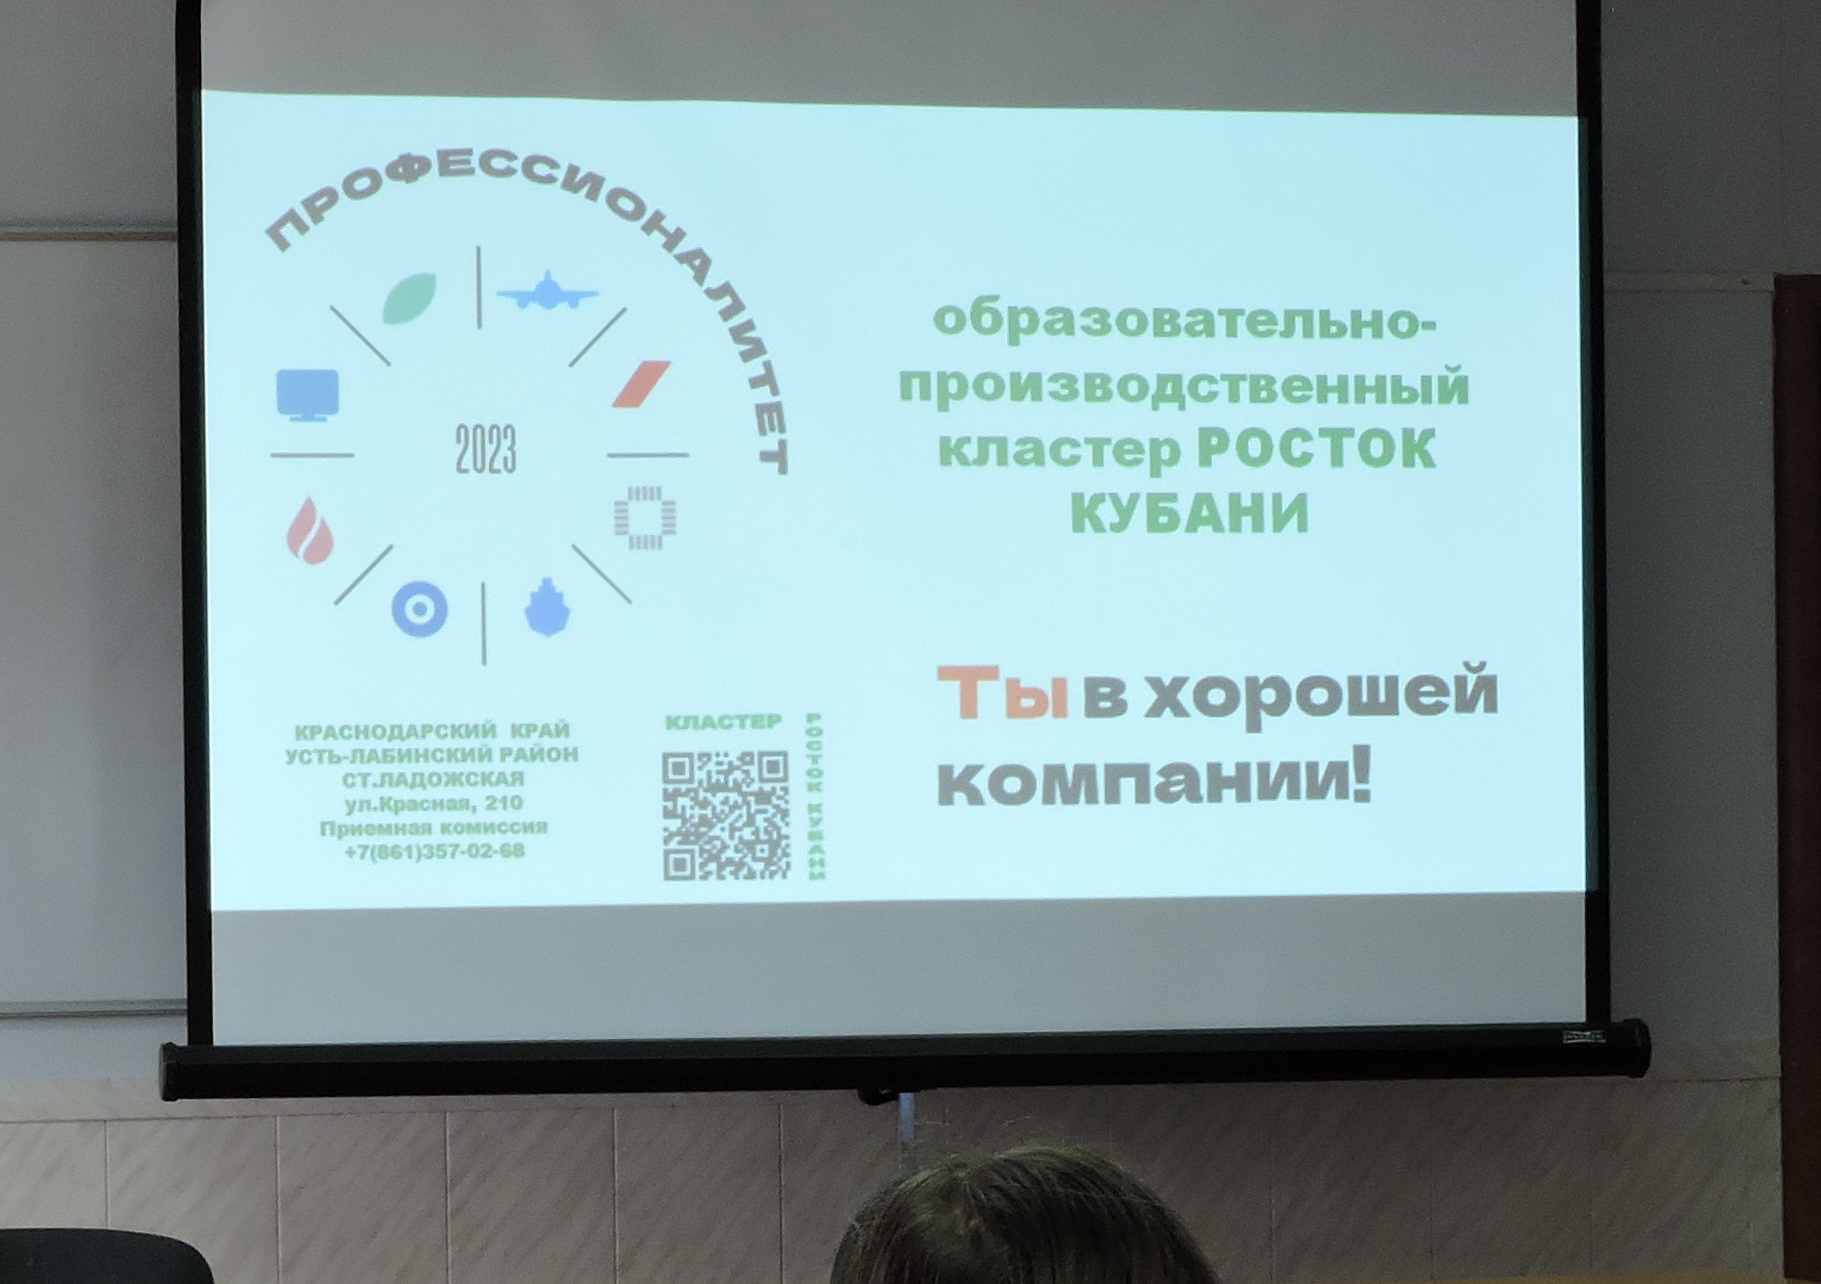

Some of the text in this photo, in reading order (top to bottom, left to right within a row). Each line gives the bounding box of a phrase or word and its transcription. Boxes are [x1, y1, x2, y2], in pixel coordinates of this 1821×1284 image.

[264, 148, 788, 475] ПРОФЕССИОНАЛИТЕТ
[933, 295, 1437, 347] образовательно-
[900, 364, 1469, 412] производственный
[456, 423, 516, 474] 2023
[939, 427, 1436, 478] кластер РОСТОК
[1071, 492, 1308, 534] КУБАНИ
[937, 661, 1498, 734] Ты в хорошей
[295, 719, 570, 742] КРАСНОДАРСКИЙ КРАЙ
[666, 714, 782, 731] КЛАСТЕР
[286, 744, 578, 765] УСТЬ-ЛАБИНСКИЙ РАЙОН
[938, 744, 1371, 806] компании!
[342, 771, 524, 790] СТ.ЛАДОЖСКАЯ
[345, 795, 523, 816] ул.Красная, 210
[320, 821, 548, 840] Приемная комиссия
[345, 843, 525, 863] +7(861)357-02-68
